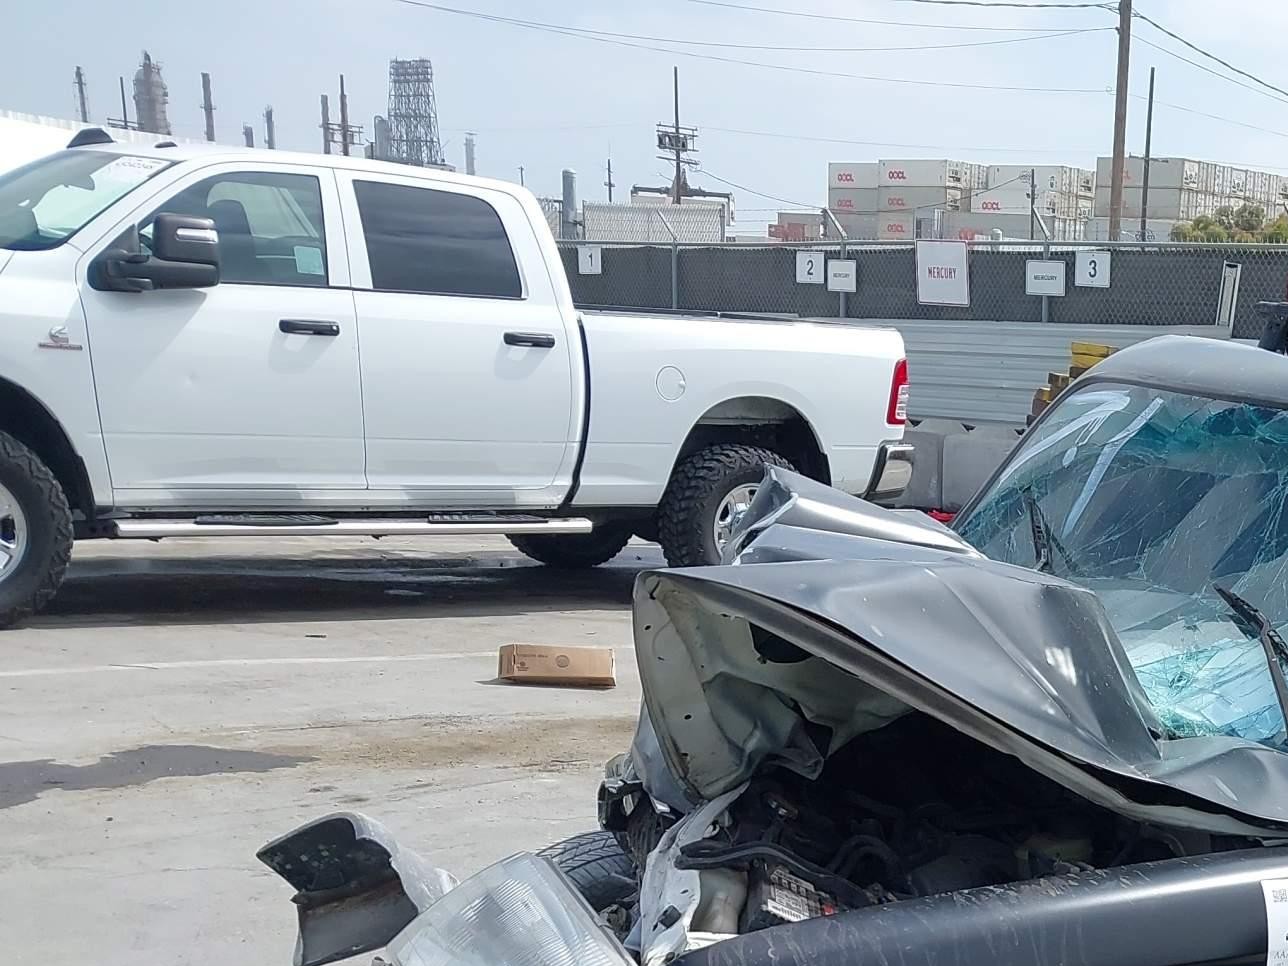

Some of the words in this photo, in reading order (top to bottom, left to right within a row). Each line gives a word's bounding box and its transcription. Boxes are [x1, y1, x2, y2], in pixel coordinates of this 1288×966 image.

[888, 170, 907, 180] OOCL
[588, 252, 593, 267] 1
[806, 259, 814, 276] 2
[927, 266, 957, 279] MERCURY
[1088, 259, 1098, 278] 3
